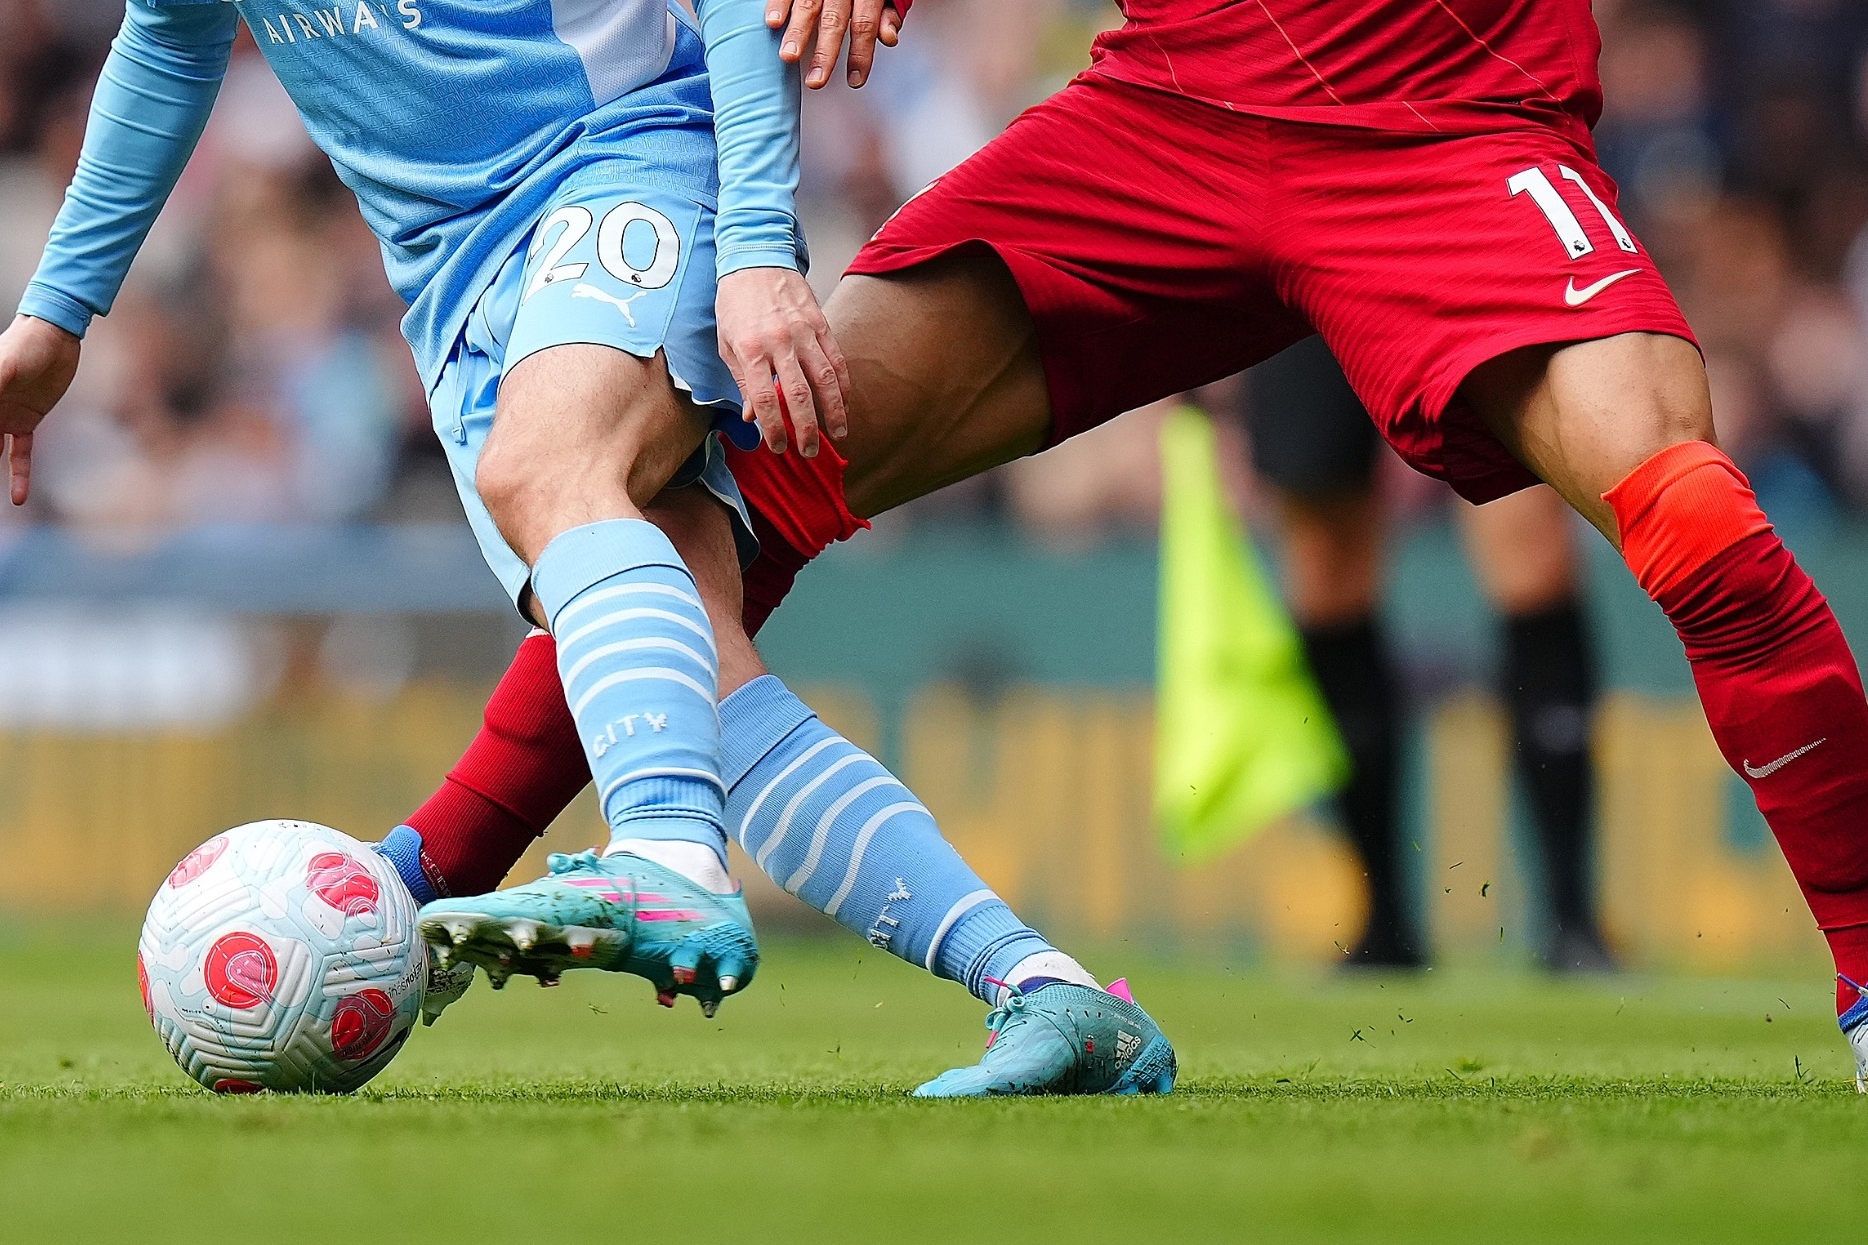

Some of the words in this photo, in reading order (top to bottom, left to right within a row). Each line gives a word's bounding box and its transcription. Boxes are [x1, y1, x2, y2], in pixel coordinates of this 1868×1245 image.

[1506, 164, 1639, 261] 11
[521, 201, 681, 306] 20
[593, 712, 667, 759] CITY
[1115, 1036, 1141, 1069] adidas
